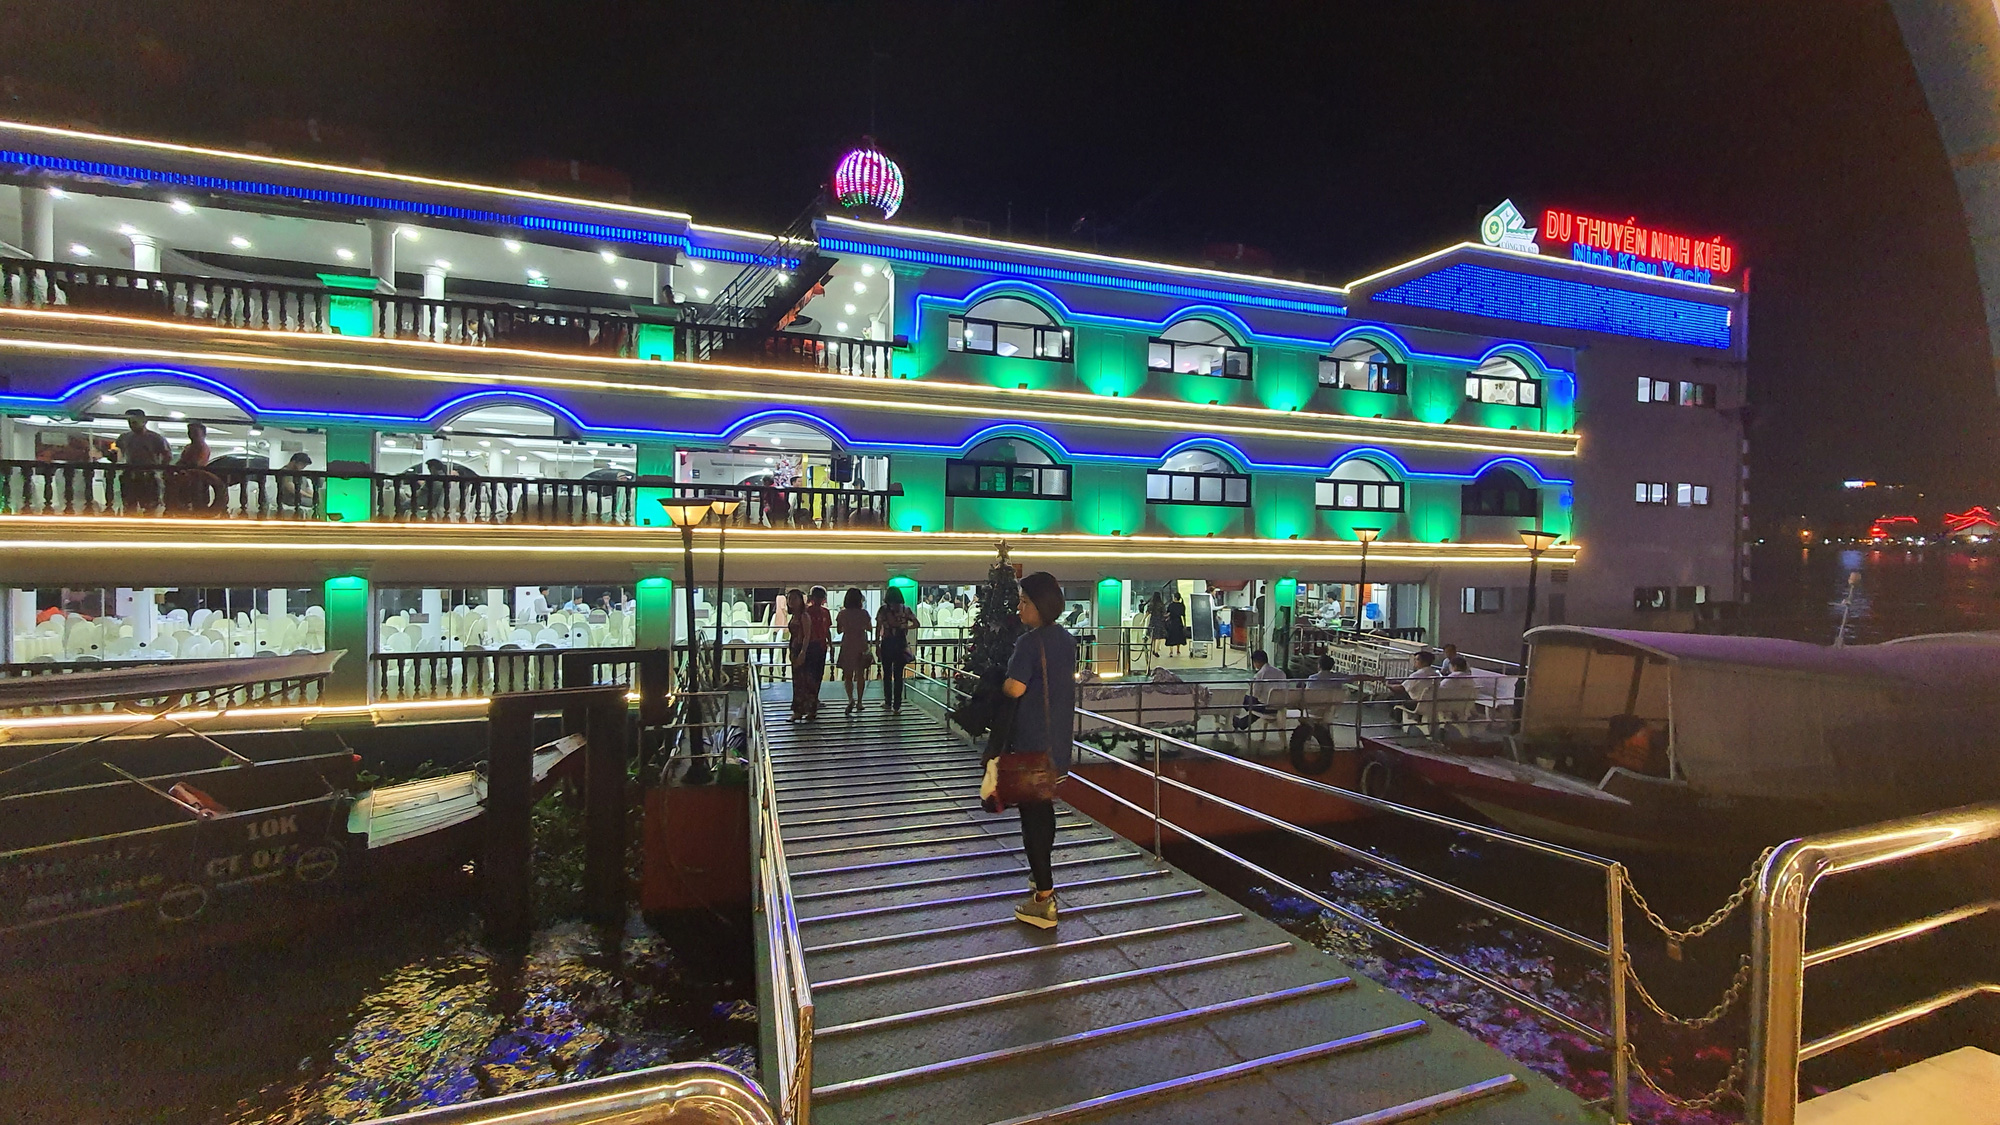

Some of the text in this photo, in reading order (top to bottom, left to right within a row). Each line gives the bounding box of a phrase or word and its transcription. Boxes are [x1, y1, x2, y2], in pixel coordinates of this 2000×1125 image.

[1546, 210, 1571, 242] DU
[1577, 216, 1647, 257] THUYỀN
[1651, 231, 1690, 265] NINH
[1573, 242, 1711, 285] Ninh Kieu Yacht
[246, 814, 298, 841] 10K
